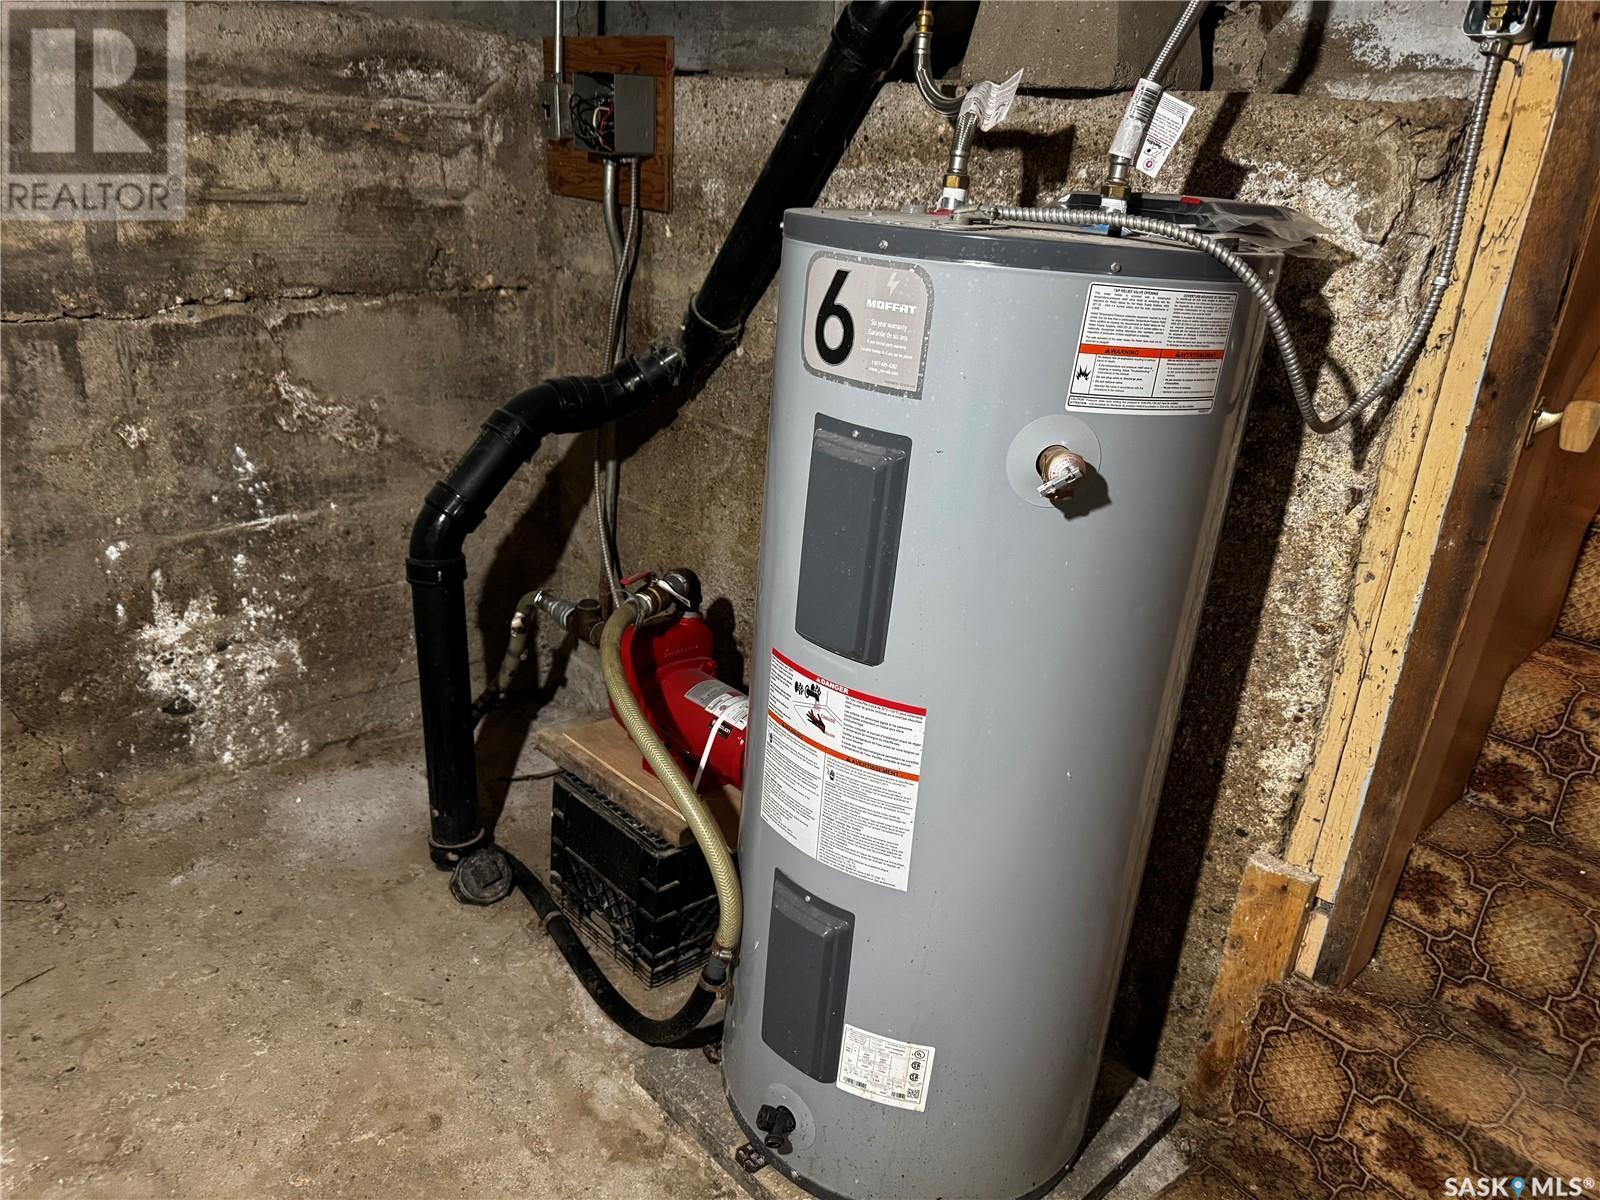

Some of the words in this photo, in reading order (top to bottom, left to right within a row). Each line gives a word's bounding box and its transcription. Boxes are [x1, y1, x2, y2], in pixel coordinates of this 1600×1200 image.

[866, 299, 917, 315] MOFFAT
[815, 269, 855, 366] 6
[1111, 347, 1139, 356] WARNING
[821, 679, 849, 694] DANGER
[851, 759, 899, 777] AVERTISSEMENT
